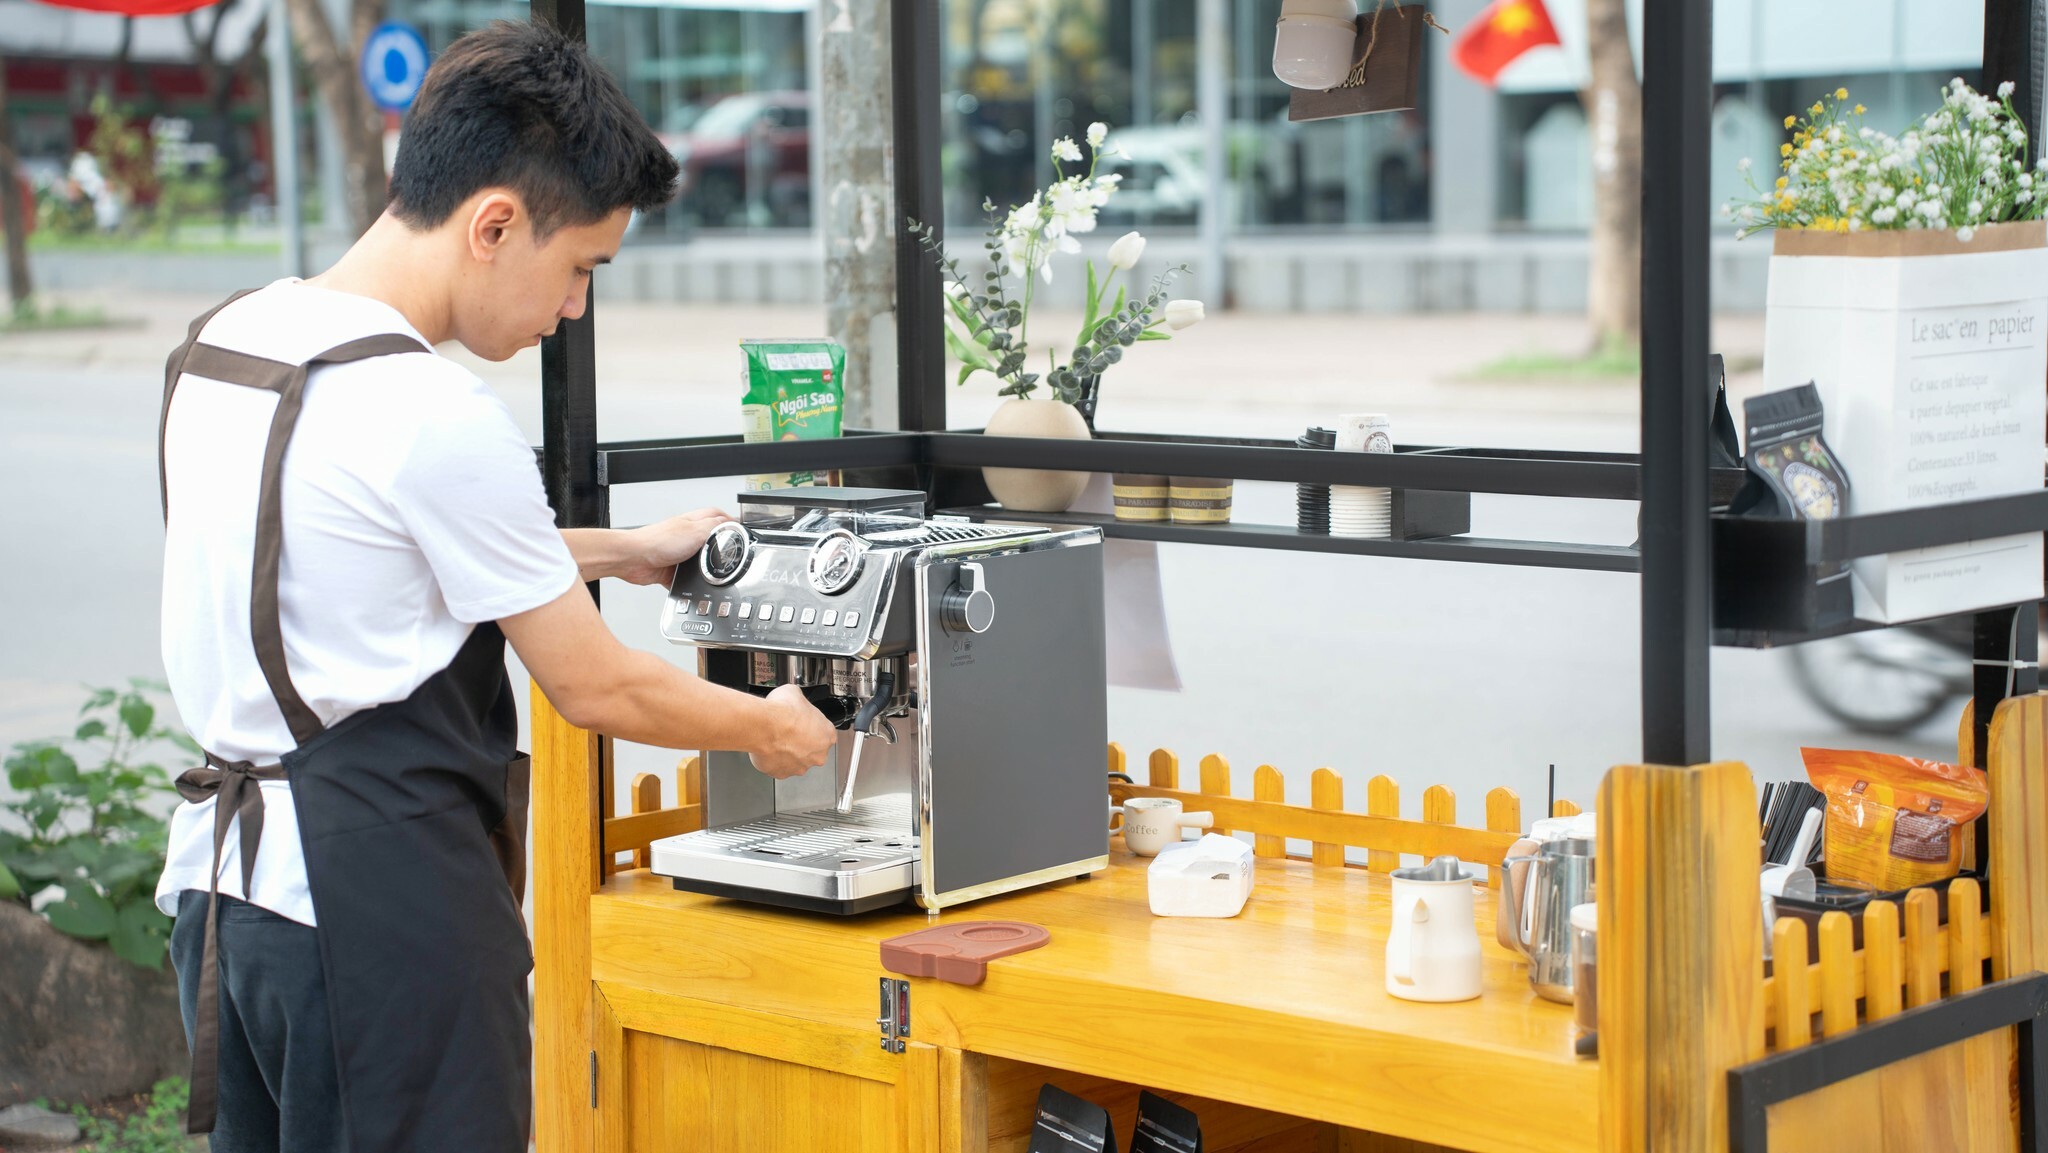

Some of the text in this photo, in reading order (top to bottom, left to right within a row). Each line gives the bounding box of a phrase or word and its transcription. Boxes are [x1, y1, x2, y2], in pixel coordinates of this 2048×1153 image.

[1911, 317, 1929, 342] Le
[1959, 318, 1978, 339] en
[1987, 309, 2035, 344] papier
[780, 392, 835, 416] Ngôi Sao
[1910, 430, 1935, 447] 100%
[1125, 823, 1158, 835] Coffee
